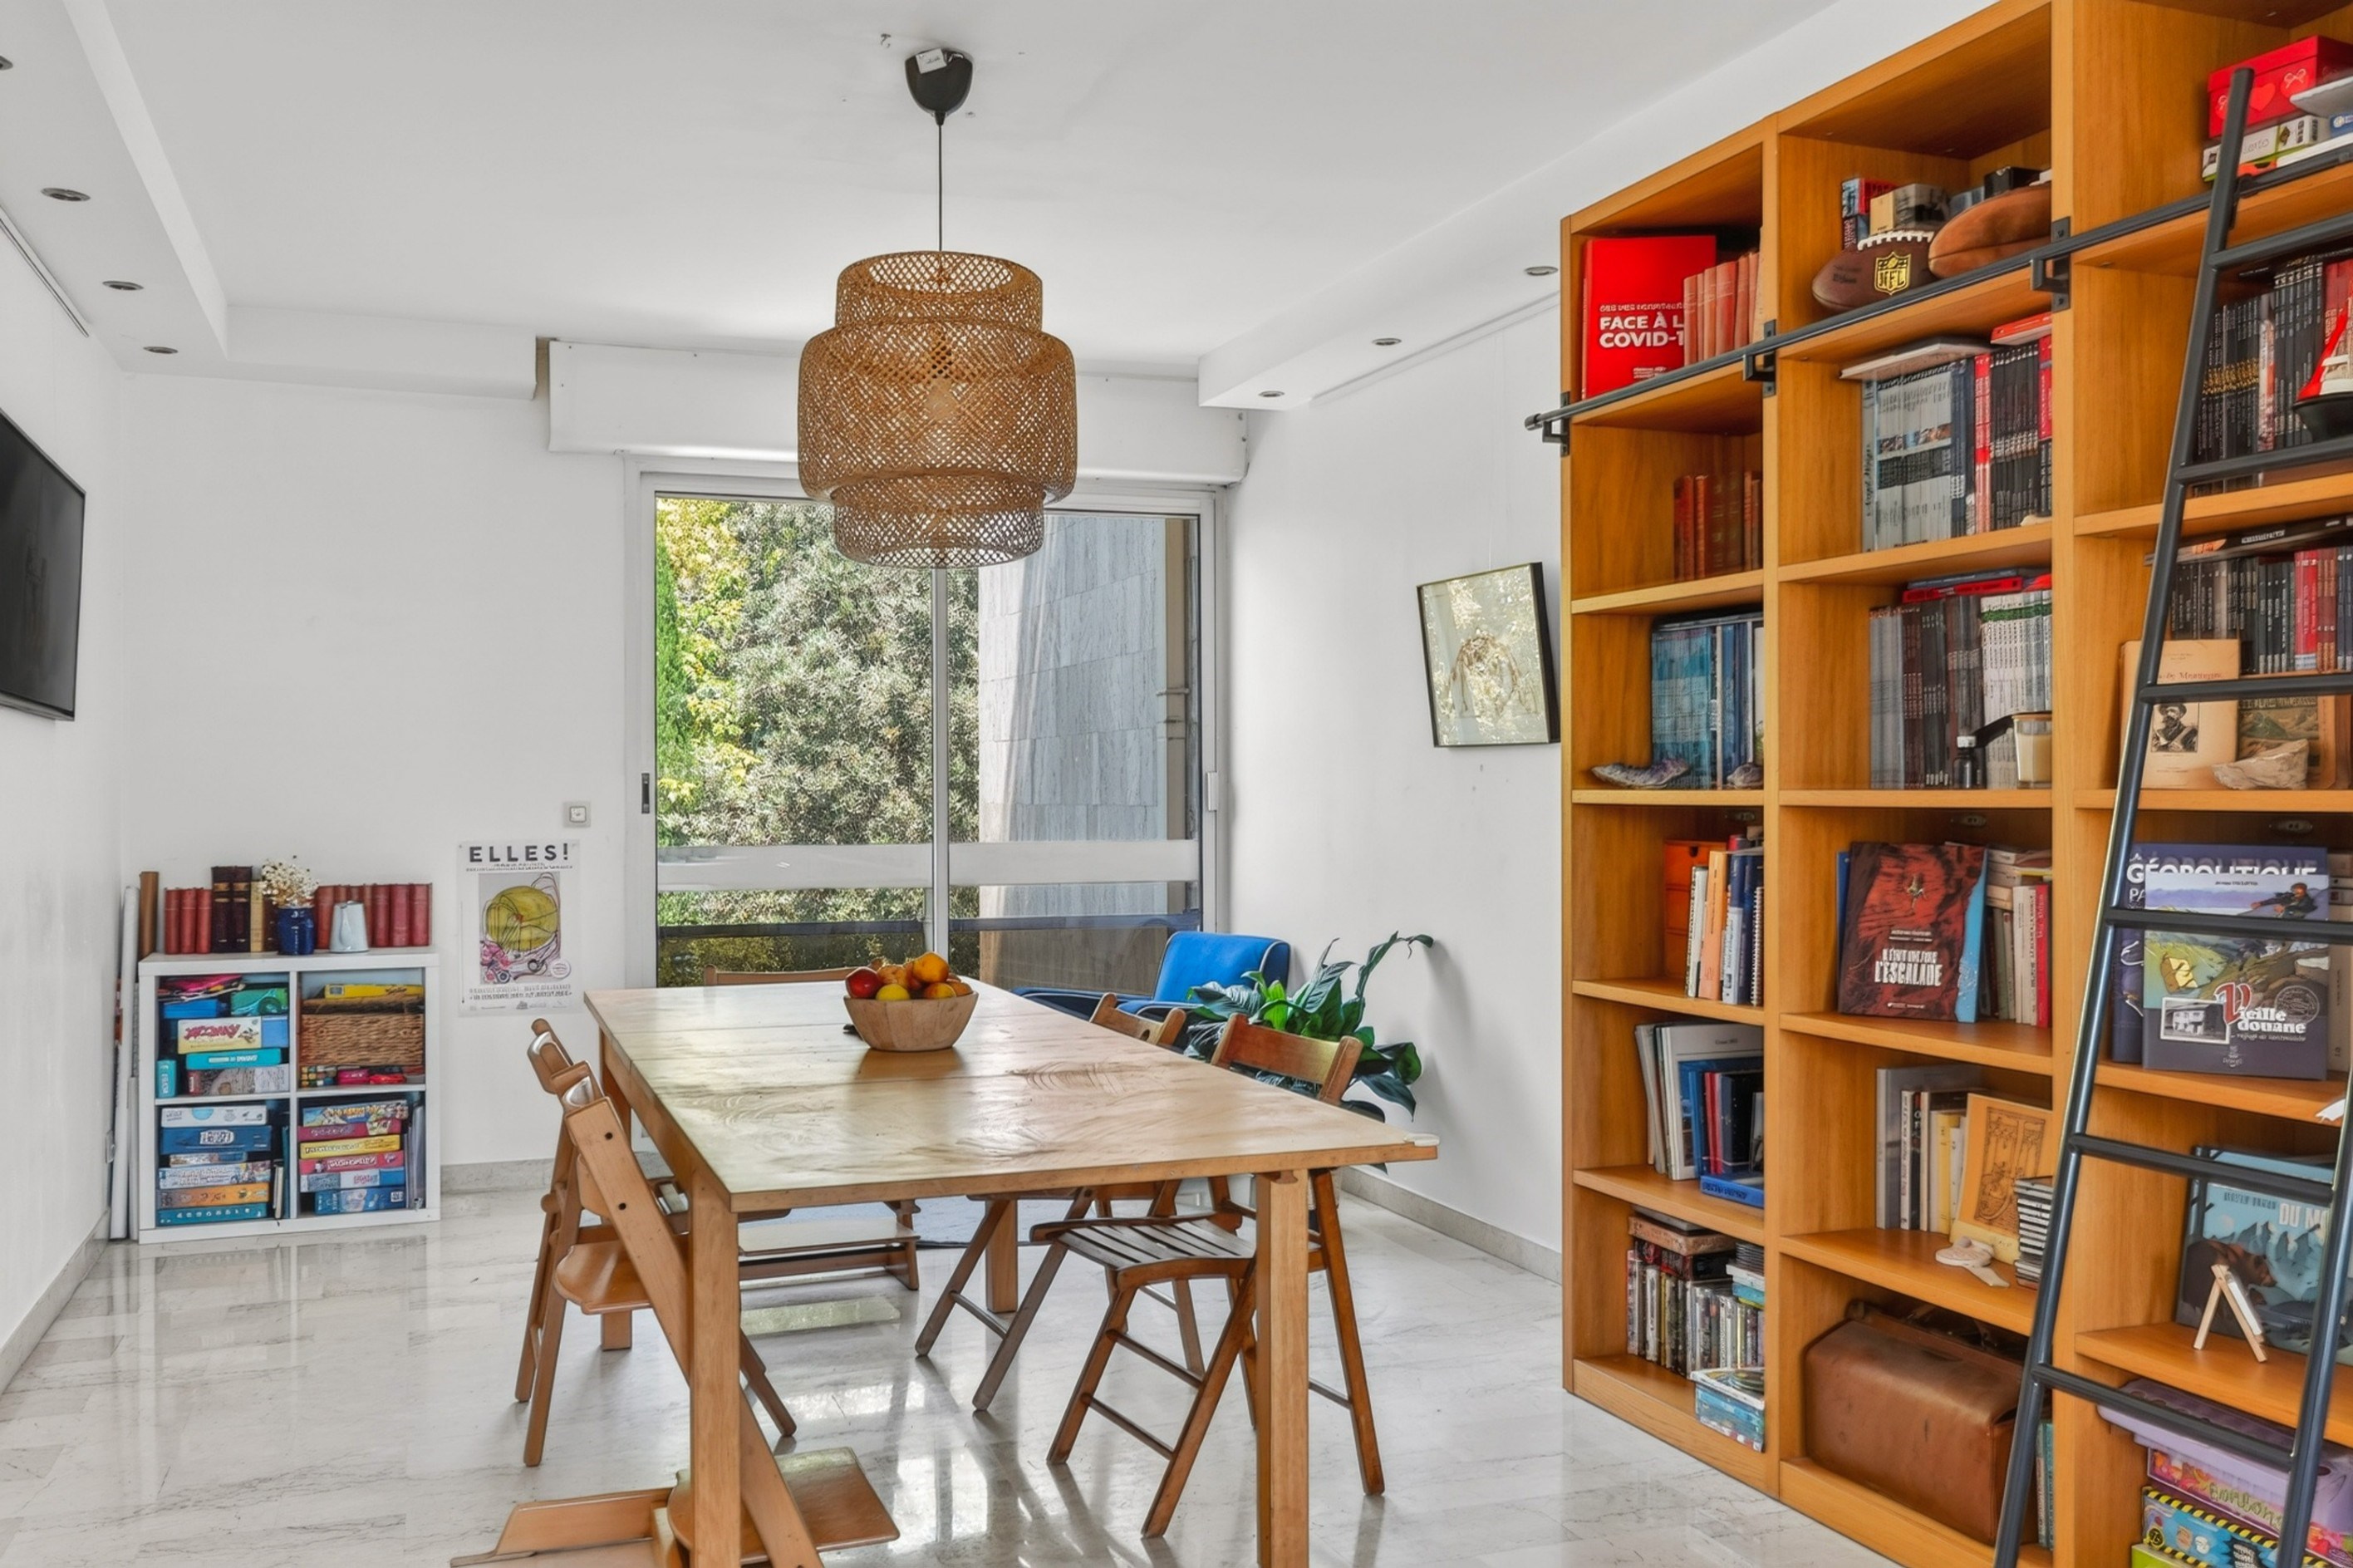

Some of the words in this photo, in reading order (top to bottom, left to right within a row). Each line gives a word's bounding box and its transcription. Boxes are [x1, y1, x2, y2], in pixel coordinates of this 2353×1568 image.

[1879, 270, 1906, 289] NFL
[1599, 315, 1649, 331] FACE
[1653, 311, 1668, 329] À
[1673, 315, 1684, 328] L
[1599, 331, 1684, 348] COVID-1
[469, 843, 568, 863] ELLES!
[2213, 982, 2287, 1025] Vieille
[2237, 1017, 2306, 1034] douane
[2278, 1202, 2301, 1228] DU
